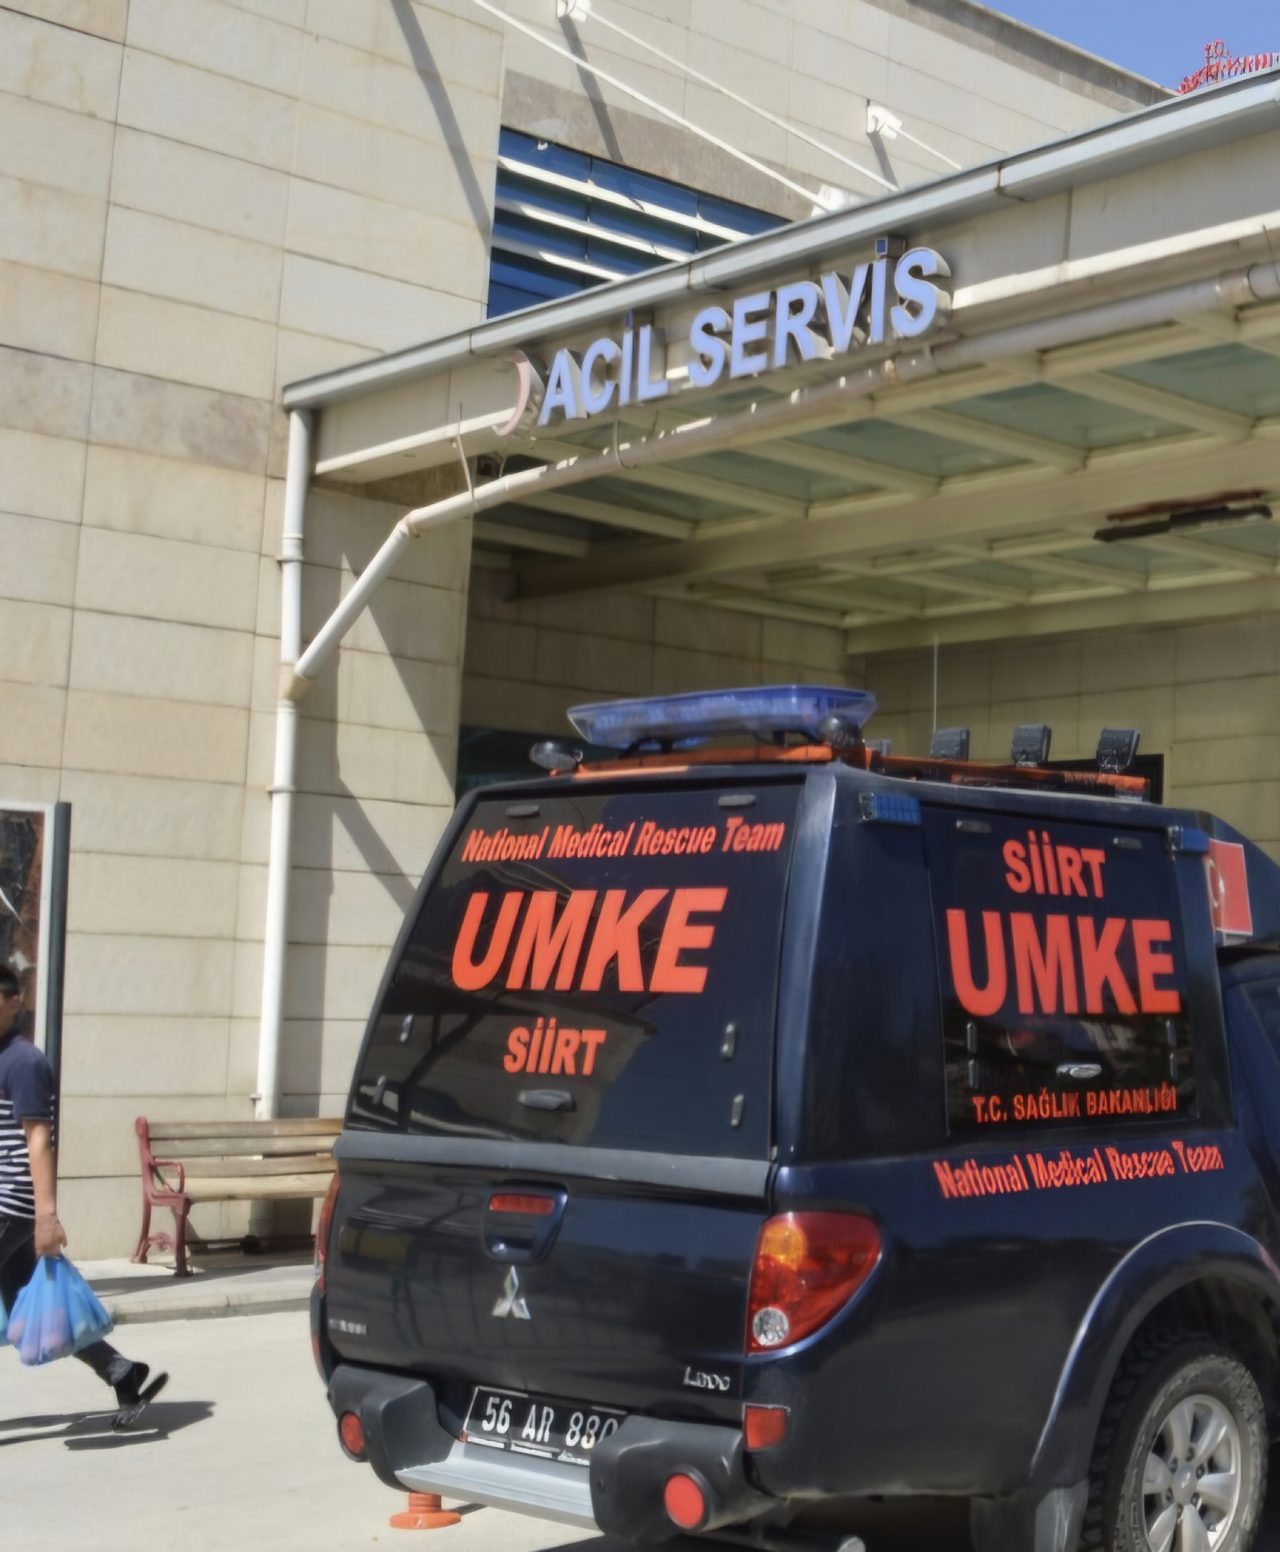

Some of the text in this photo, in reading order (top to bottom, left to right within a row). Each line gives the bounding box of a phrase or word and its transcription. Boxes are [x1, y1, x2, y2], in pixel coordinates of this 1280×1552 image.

[538, 238, 949, 427] ACİL SERVİS
[461, 816, 786, 863] National Medical Rescue Team
[1002, 829, 1106, 899] SİİRT
[451, 887, 728, 994] UMKE
[946, 908, 1182, 1018] UMKE
[503, 1016, 608, 1077] SİİRT
[972, 1081, 1178, 1124] T.C. SAĞLIK BAKANLIĞI
[932, 1138, 1225, 1200] National Medical Rescue Team
[481, 1396, 513, 1434] 56
[521, 1403, 555, 1443] AR
